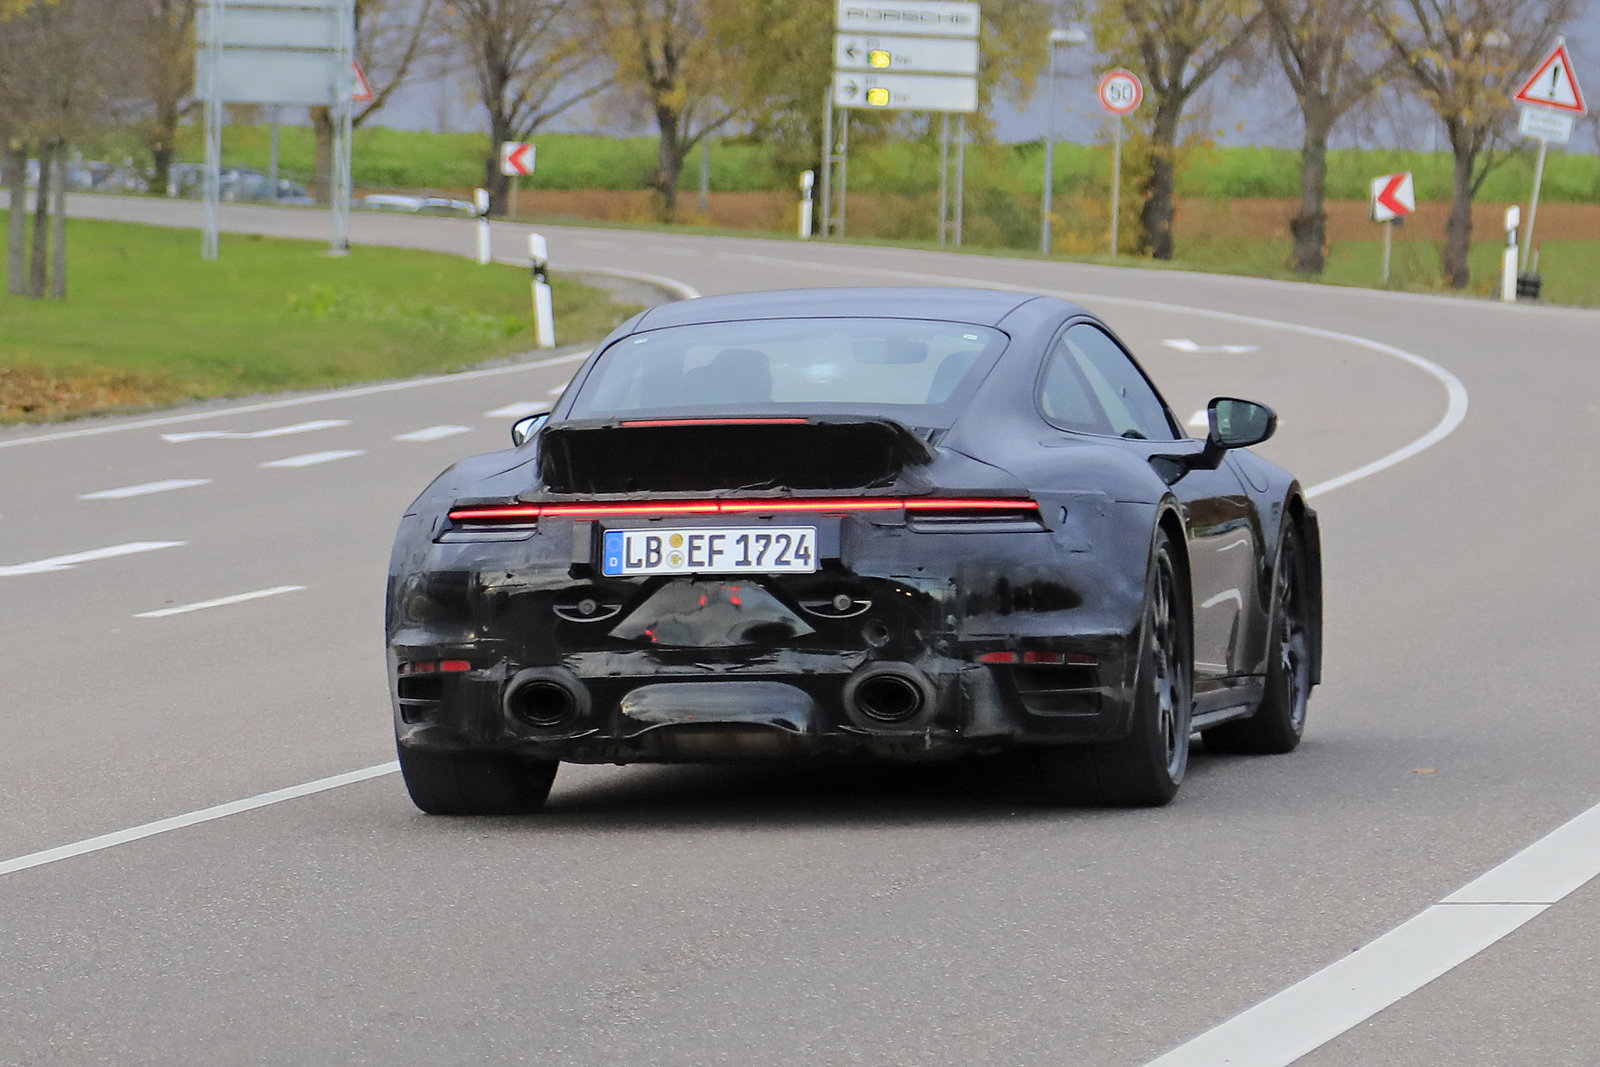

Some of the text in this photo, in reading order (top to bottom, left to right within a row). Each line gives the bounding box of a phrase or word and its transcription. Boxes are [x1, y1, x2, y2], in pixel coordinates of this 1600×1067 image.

[847, 8, 973, 25] PORSCHE
[1110, 83, 1133, 102] 50
[625, 534, 811, 568] LB EF 1724
[609, 557, 618, 567] D
